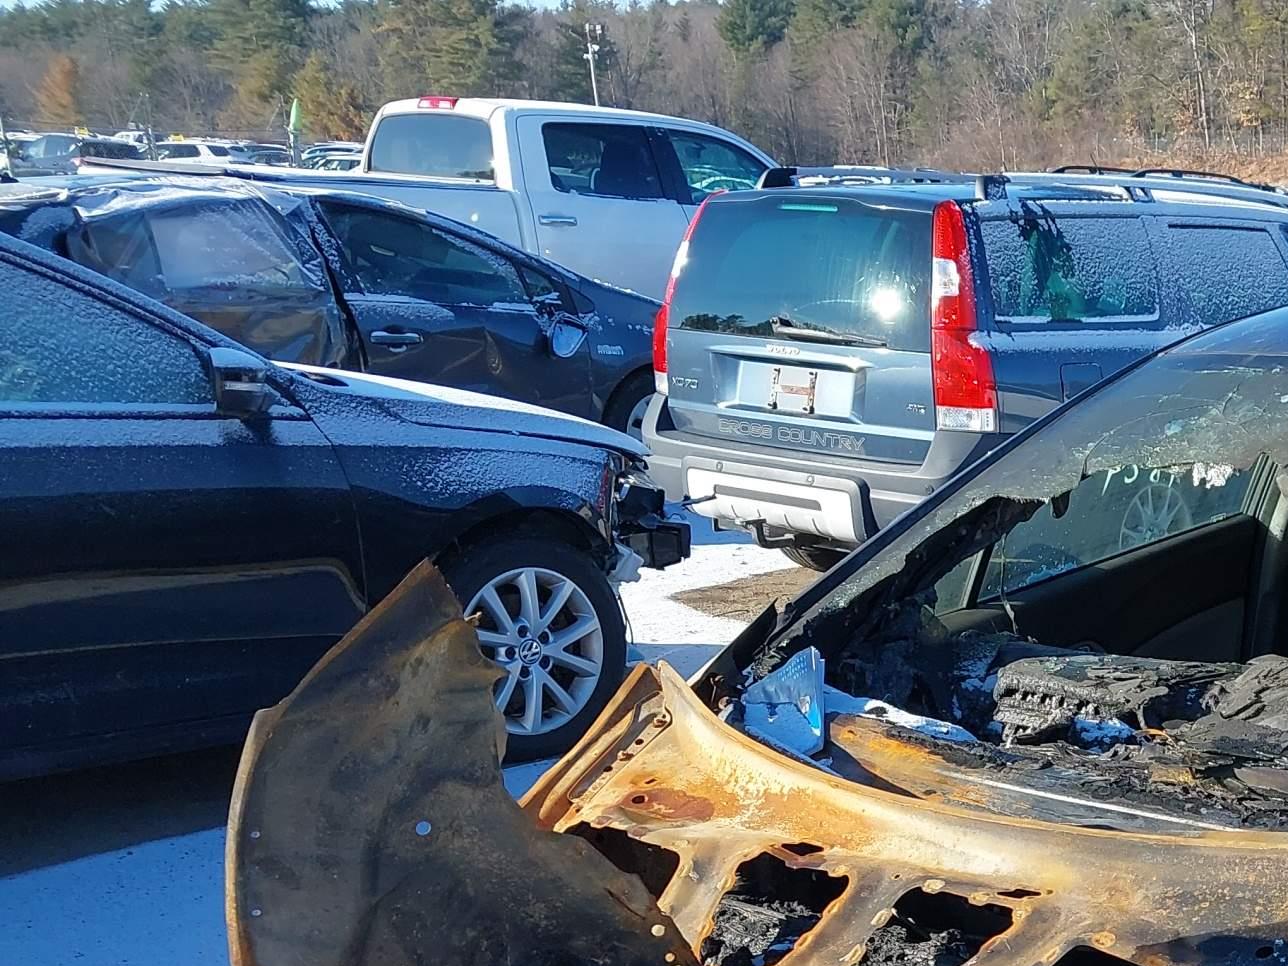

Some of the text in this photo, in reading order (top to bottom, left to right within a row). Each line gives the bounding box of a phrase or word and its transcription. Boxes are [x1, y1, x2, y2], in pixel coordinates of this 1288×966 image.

[766, 343, 800, 356] VOLVO
[719, 417, 866, 451] CROSS COUNTRY
